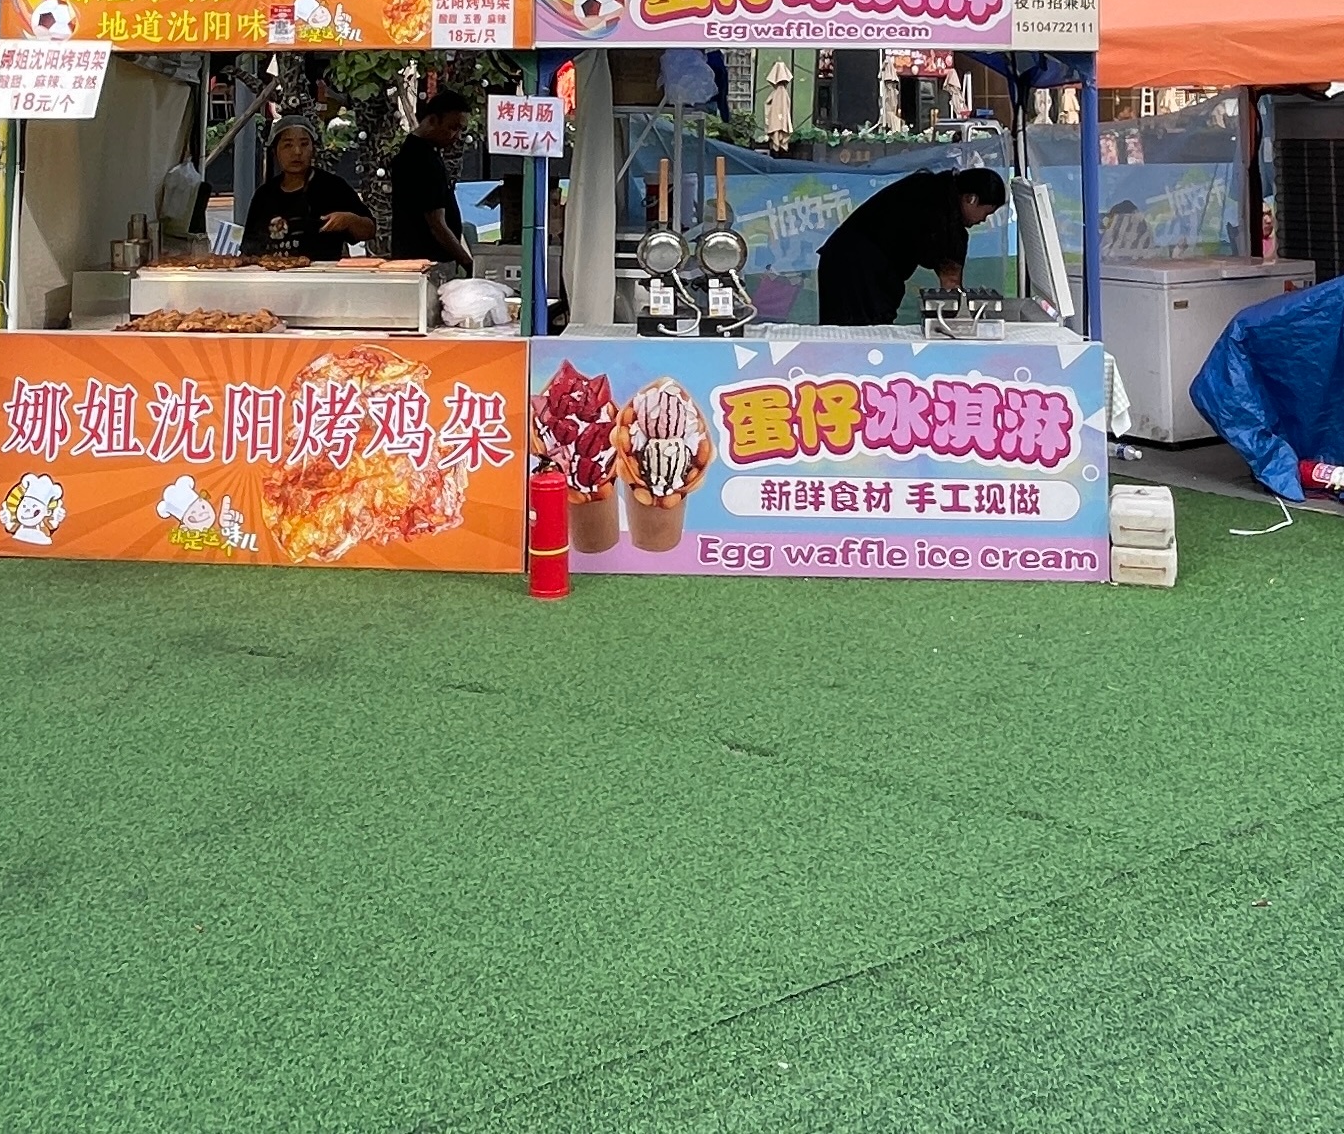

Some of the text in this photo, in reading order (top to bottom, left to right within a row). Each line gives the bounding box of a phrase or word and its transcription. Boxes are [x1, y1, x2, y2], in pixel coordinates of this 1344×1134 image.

[95, 10, 269, 42] 地道沈阳味
[463, 14, 482, 25] 五香
[706, 22, 930, 39] Egg waffle ice cream
[1016, 21, 1093, 33] 15104722111
[448, 29, 497, 44] 18元/只
[0, 48, 107, 72] 娜姐沈阳烤鸡架
[13, 92, 75, 113] 18元/个
[497, 101, 554, 123] 烤肉肠
[493, 130, 557, 152] 12元/个
[3, 377, 514, 472] 娜姐沈阳烤鸡架
[721, 381, 1073, 464] 蛋仔冰淇淋
[760, 480, 1041, 515] 新鲜食材 手工现做
[699, 538, 1097, 571] Egg waffle ice cream
